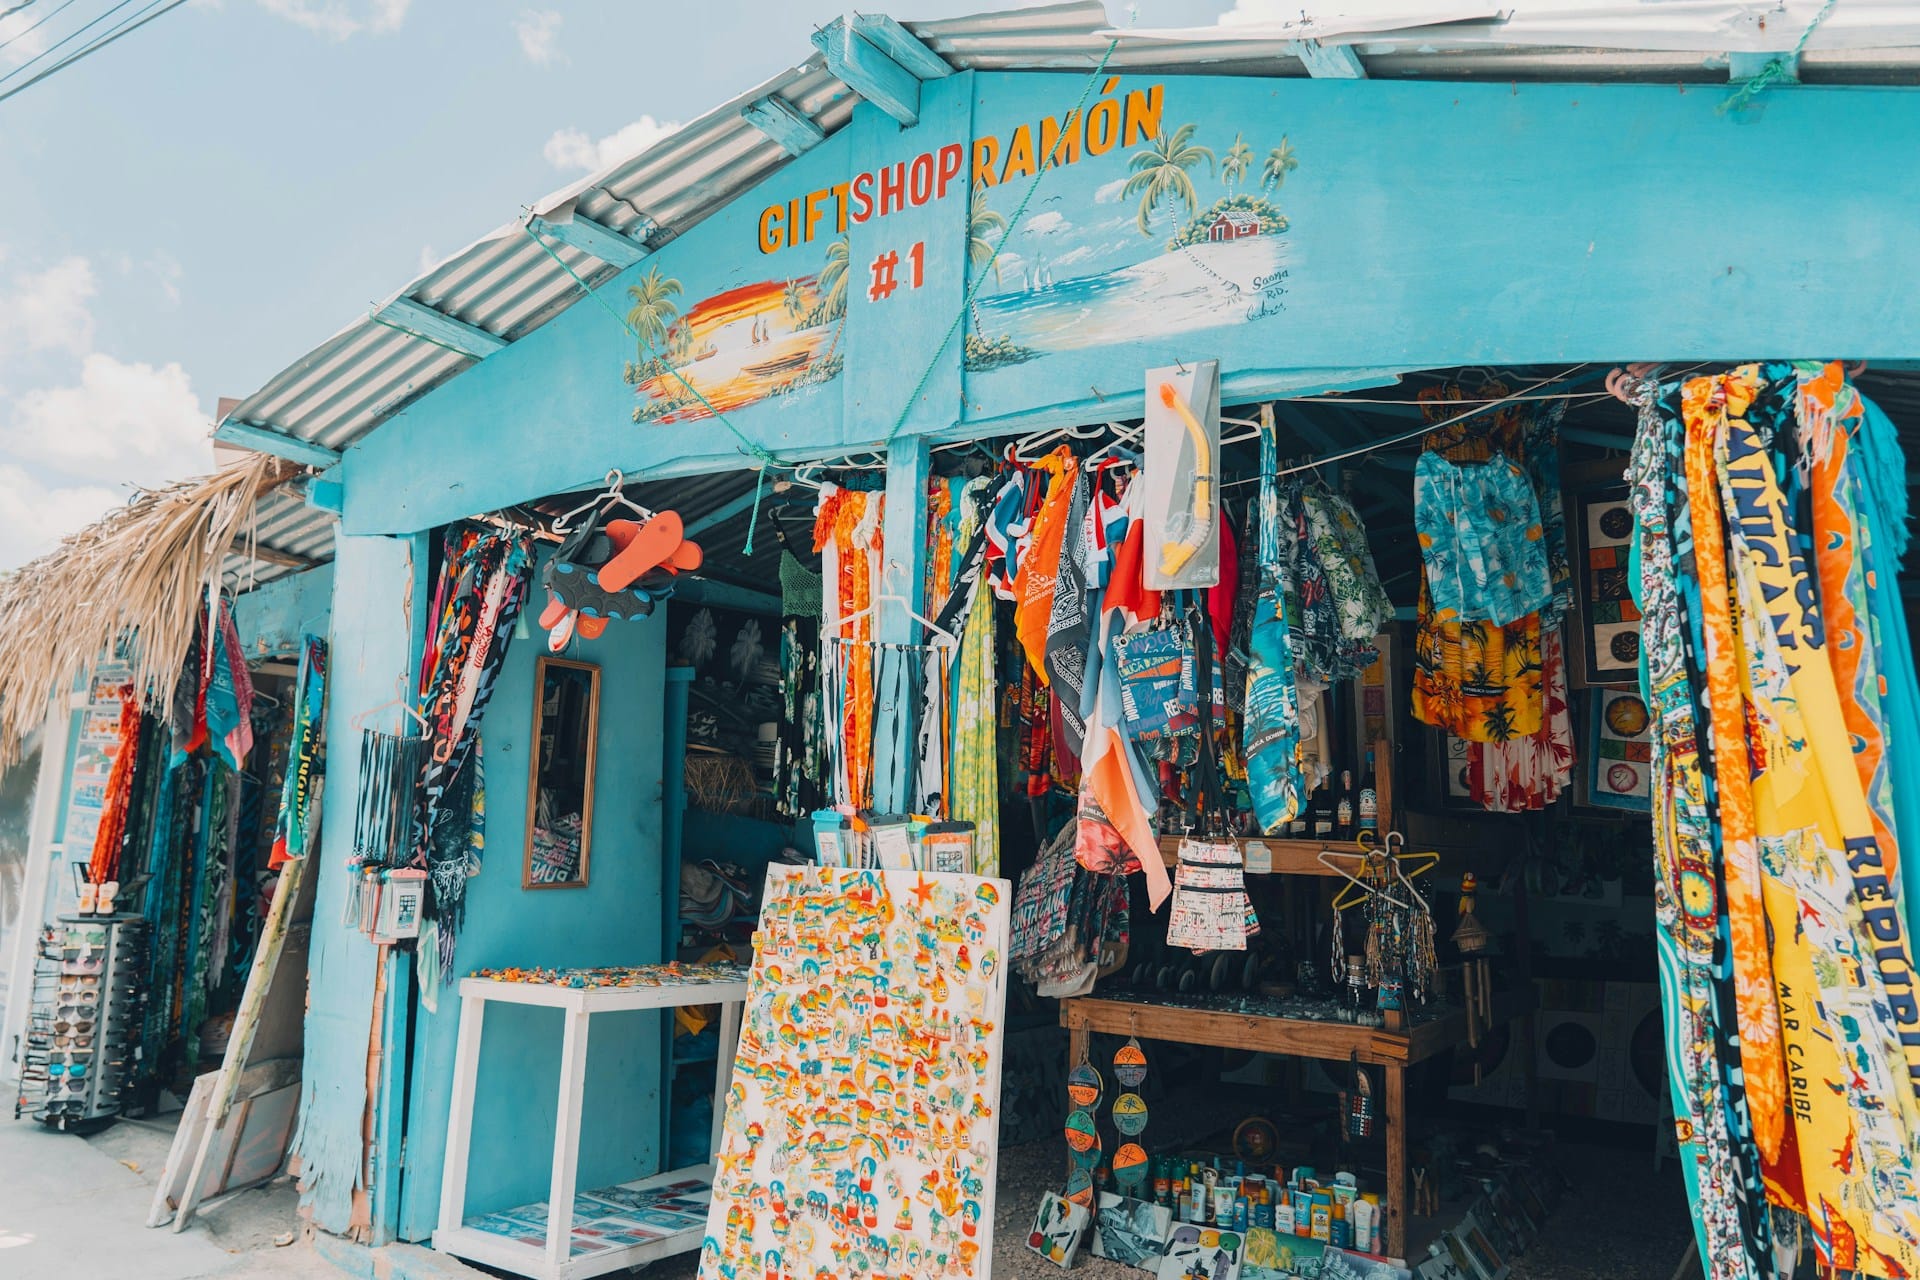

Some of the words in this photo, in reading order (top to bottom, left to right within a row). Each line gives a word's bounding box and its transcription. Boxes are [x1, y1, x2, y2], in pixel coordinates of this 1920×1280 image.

[758, 181, 850, 255] GIFT
[850, 142, 964, 225] SHOP
[971, 76, 1165, 189] RAMÓN
[1252, 269, 1289, 291] Saona
[1779, 981, 1801, 1031] MAR
[1786, 1042, 1812, 1124] CARIBE
